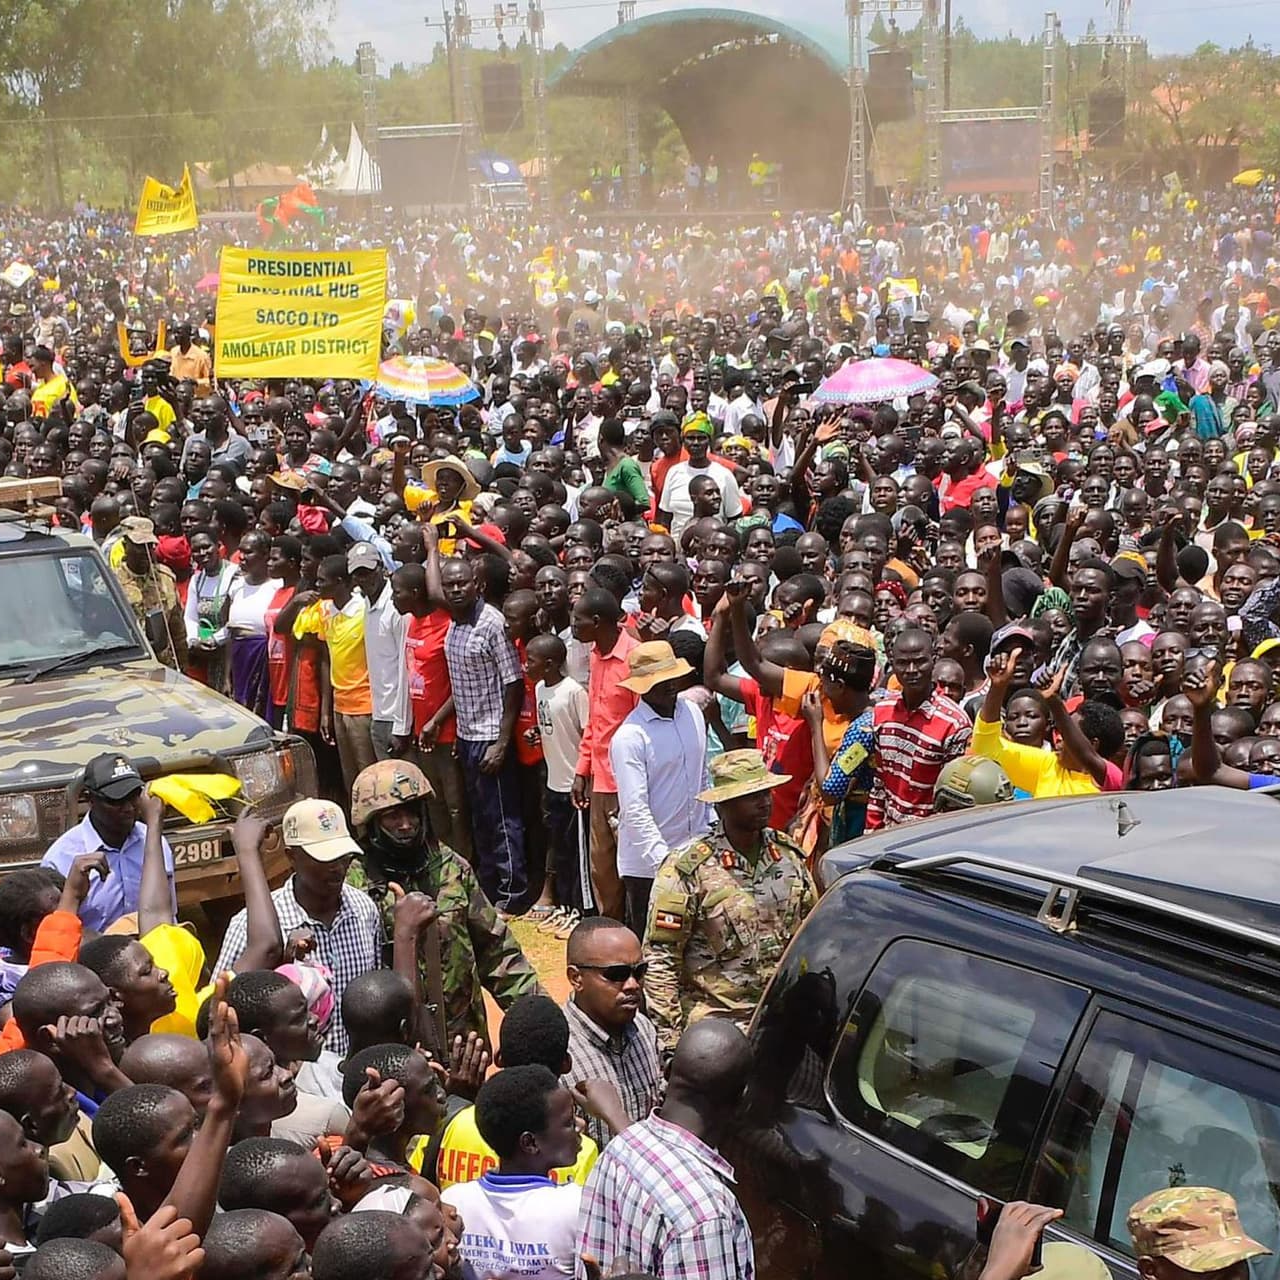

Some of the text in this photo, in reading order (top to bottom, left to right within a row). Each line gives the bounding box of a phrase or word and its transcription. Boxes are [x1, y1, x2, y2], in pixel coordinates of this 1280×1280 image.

[247, 258, 355, 277] PRESIDENTIAL
[328, 282, 360, 298] HUB
[256, 309, 339, 327] SACCO LTD
[221, 338, 369, 358] AMOLATAR DISTRICT
[174, 839, 222, 865] 2981
[462, 1233, 496, 1248] TEK
